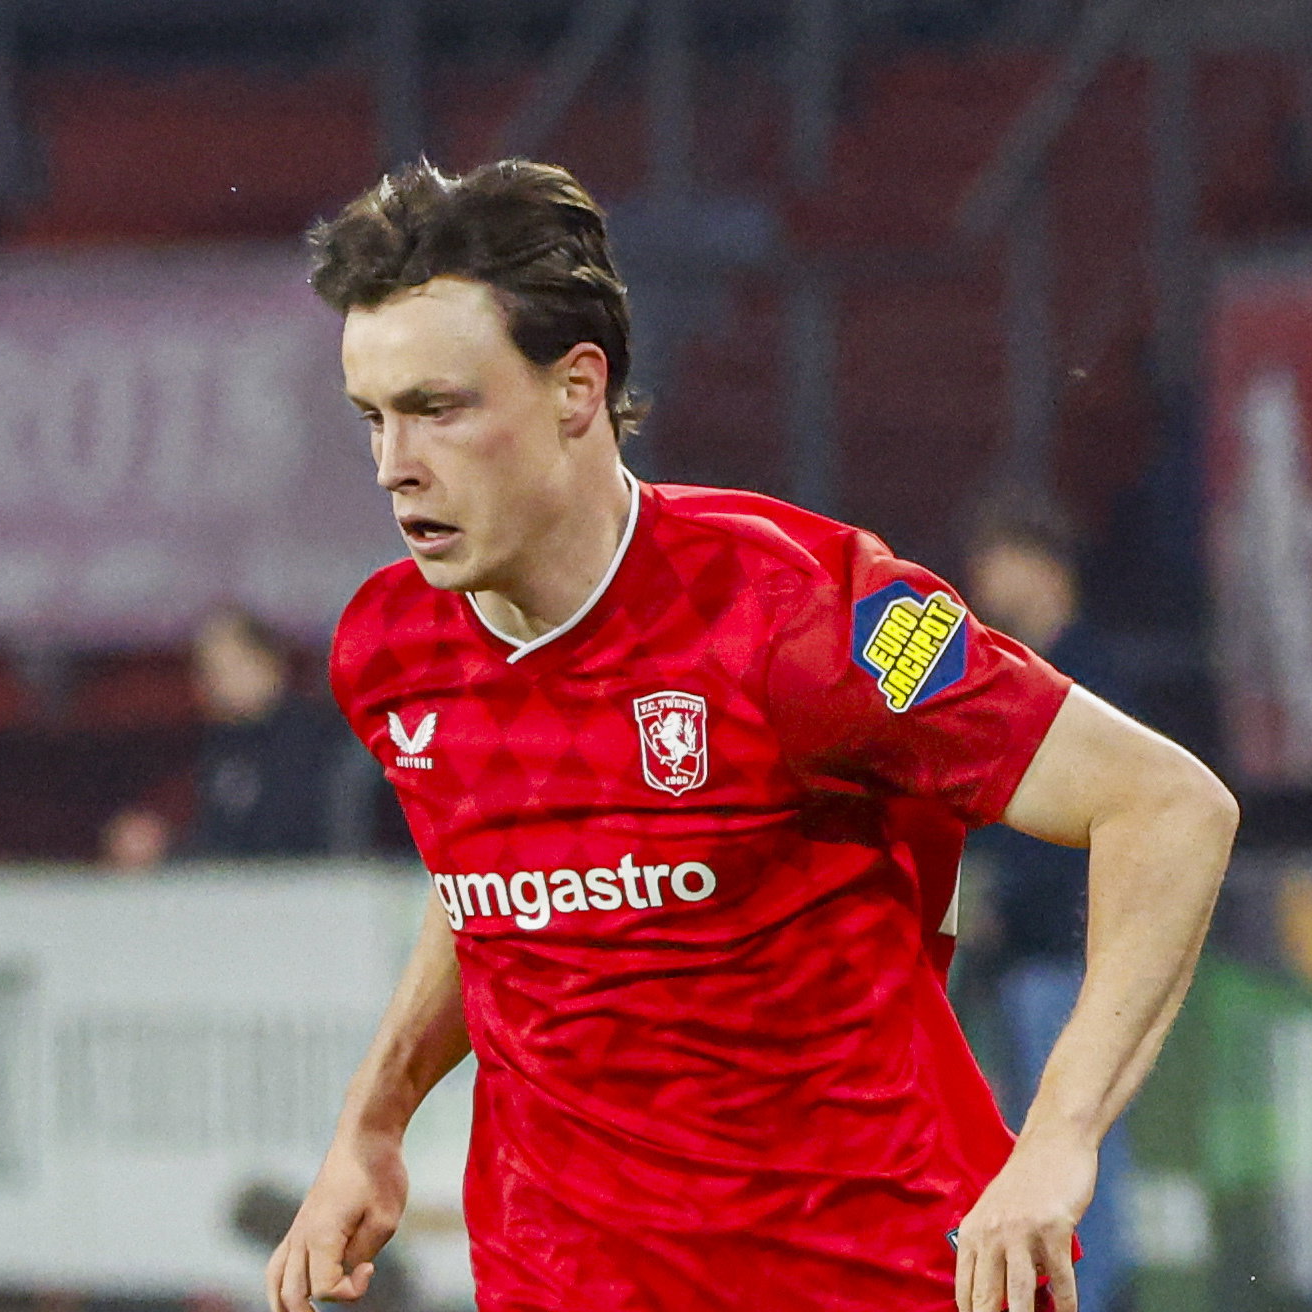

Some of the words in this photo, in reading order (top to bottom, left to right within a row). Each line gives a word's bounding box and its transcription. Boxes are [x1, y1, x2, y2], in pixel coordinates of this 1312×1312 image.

[866, 605, 919, 671] EURO
[882, 601, 958, 709] JACKPOT
[432, 853, 716, 931] gmgastro
